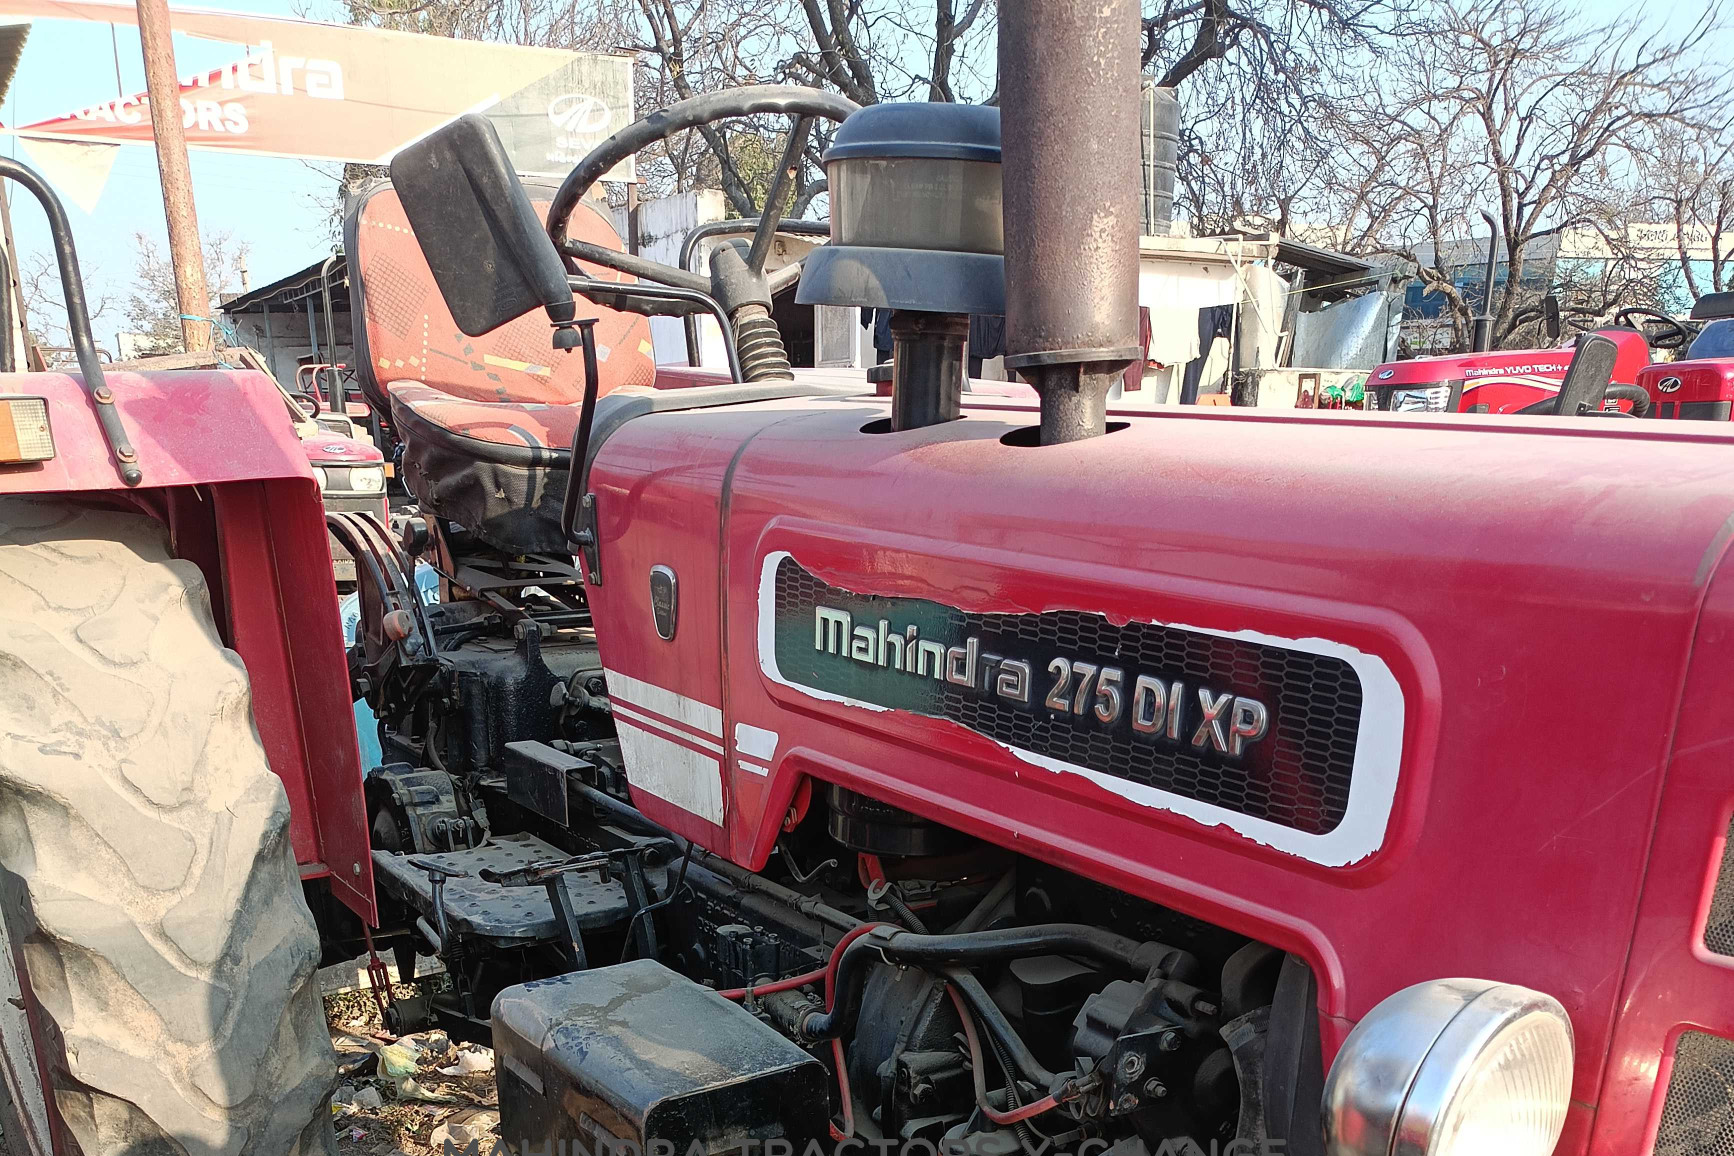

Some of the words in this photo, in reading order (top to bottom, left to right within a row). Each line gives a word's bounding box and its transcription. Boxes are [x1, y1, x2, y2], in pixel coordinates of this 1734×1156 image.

[1505, 365, 1532, 375] YUVO
[814, 604, 1031, 704] Mahindra
[1045, 656, 1125, 724] 275
[1132, 674, 1184, 741] DI
[1191, 687, 1270, 756] XP
